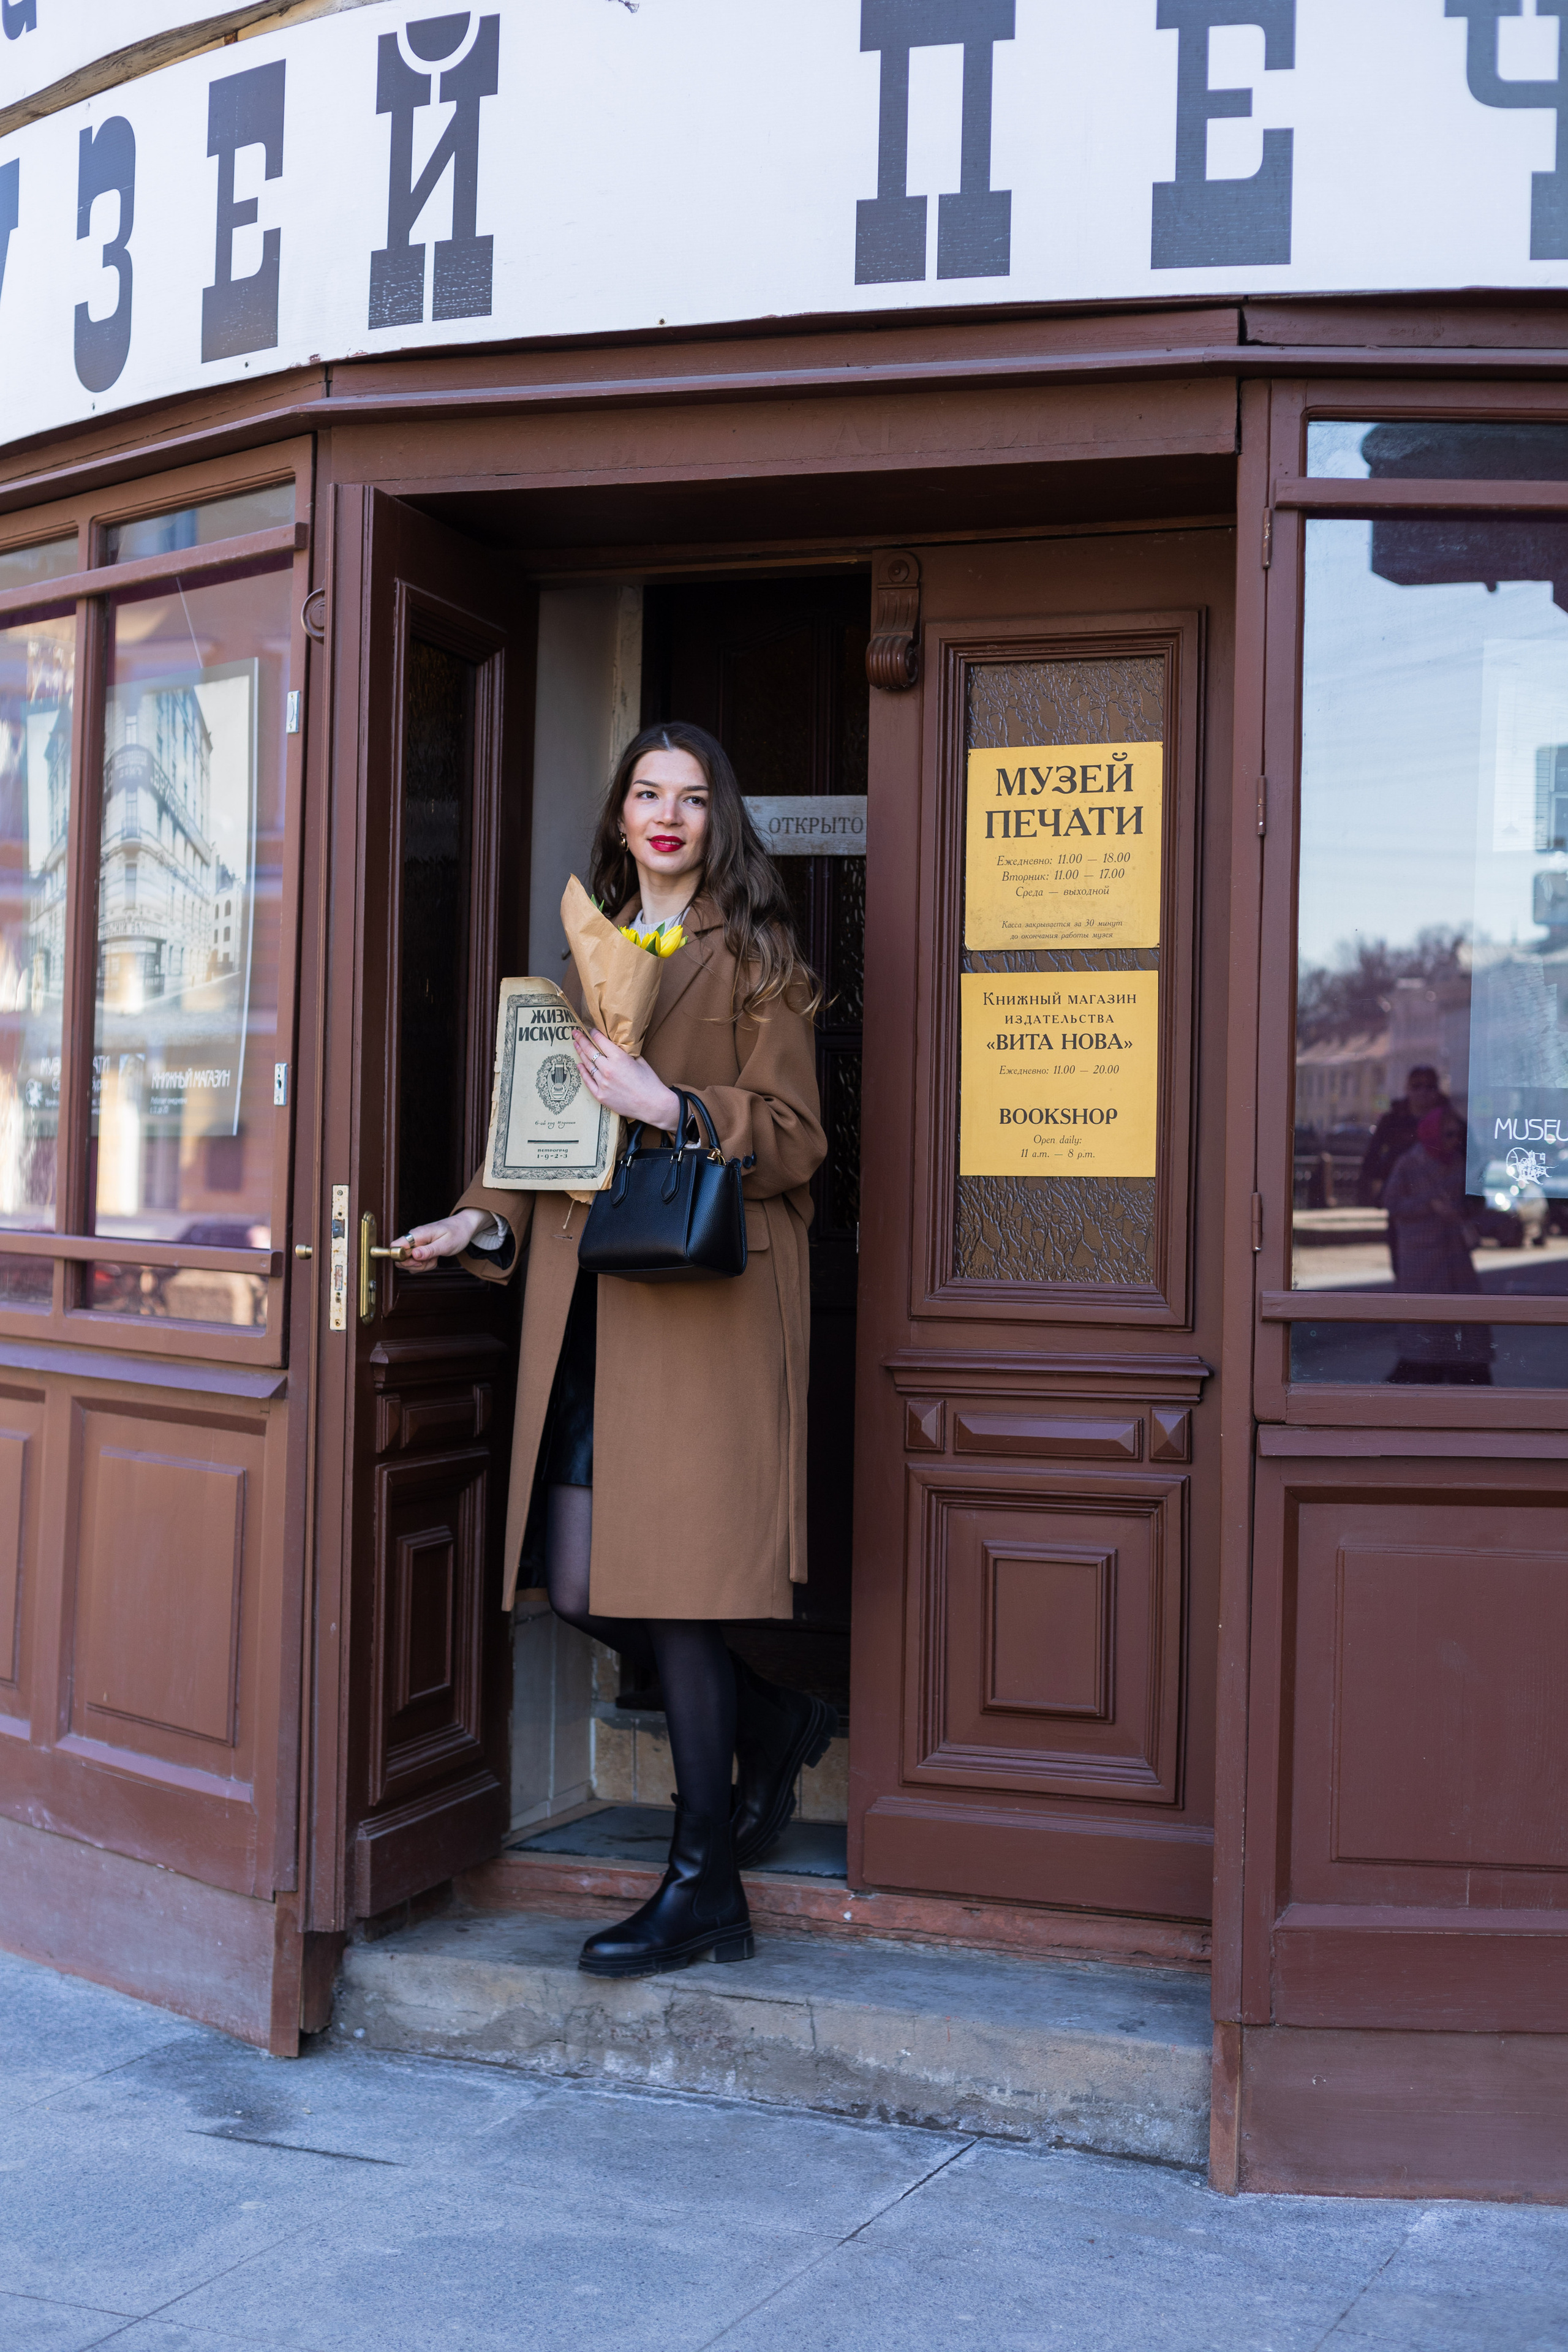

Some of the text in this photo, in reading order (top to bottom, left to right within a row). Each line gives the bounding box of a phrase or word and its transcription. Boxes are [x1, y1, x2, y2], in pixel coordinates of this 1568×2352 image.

[995, 752, 1134, 797] МУЗЕЙ
[769, 817, 863, 834] ОТКРЫТО
[984, 805, 1144, 839] ПЕЧАТИ
[997, 855, 1053, 867] Ежедневно:
[1058, 853, 1083, 864] 11.00
[1102, 851, 1131, 863] 18.00
[1001, 871, 1049, 883] Вторник:
[1054, 869, 1079, 880] 11.00
[1099, 868, 1125, 879] 17.00
[1016, 886, 1044, 899] Среда
[1063, 885, 1109, 896] выходной
[1060, 931, 1089, 940] работы
[986, 1033, 1133, 1050] «ВИТА НОВА»
[192, 1069, 230, 1088] МАГАЗИН
[998, 1065, 1049, 1076] Ежедневно:
[1053, 1065, 1076, 1074] 11.00
[1093, 1065, 1120, 1074] 20.00
[999, 1107, 1118, 1125] BOOKSHOP
[1033, 1134, 1082, 1146] Open daily:
[1020, 1148, 1028, 1158] 11
[1067, 1148, 1074, 1158] 8
